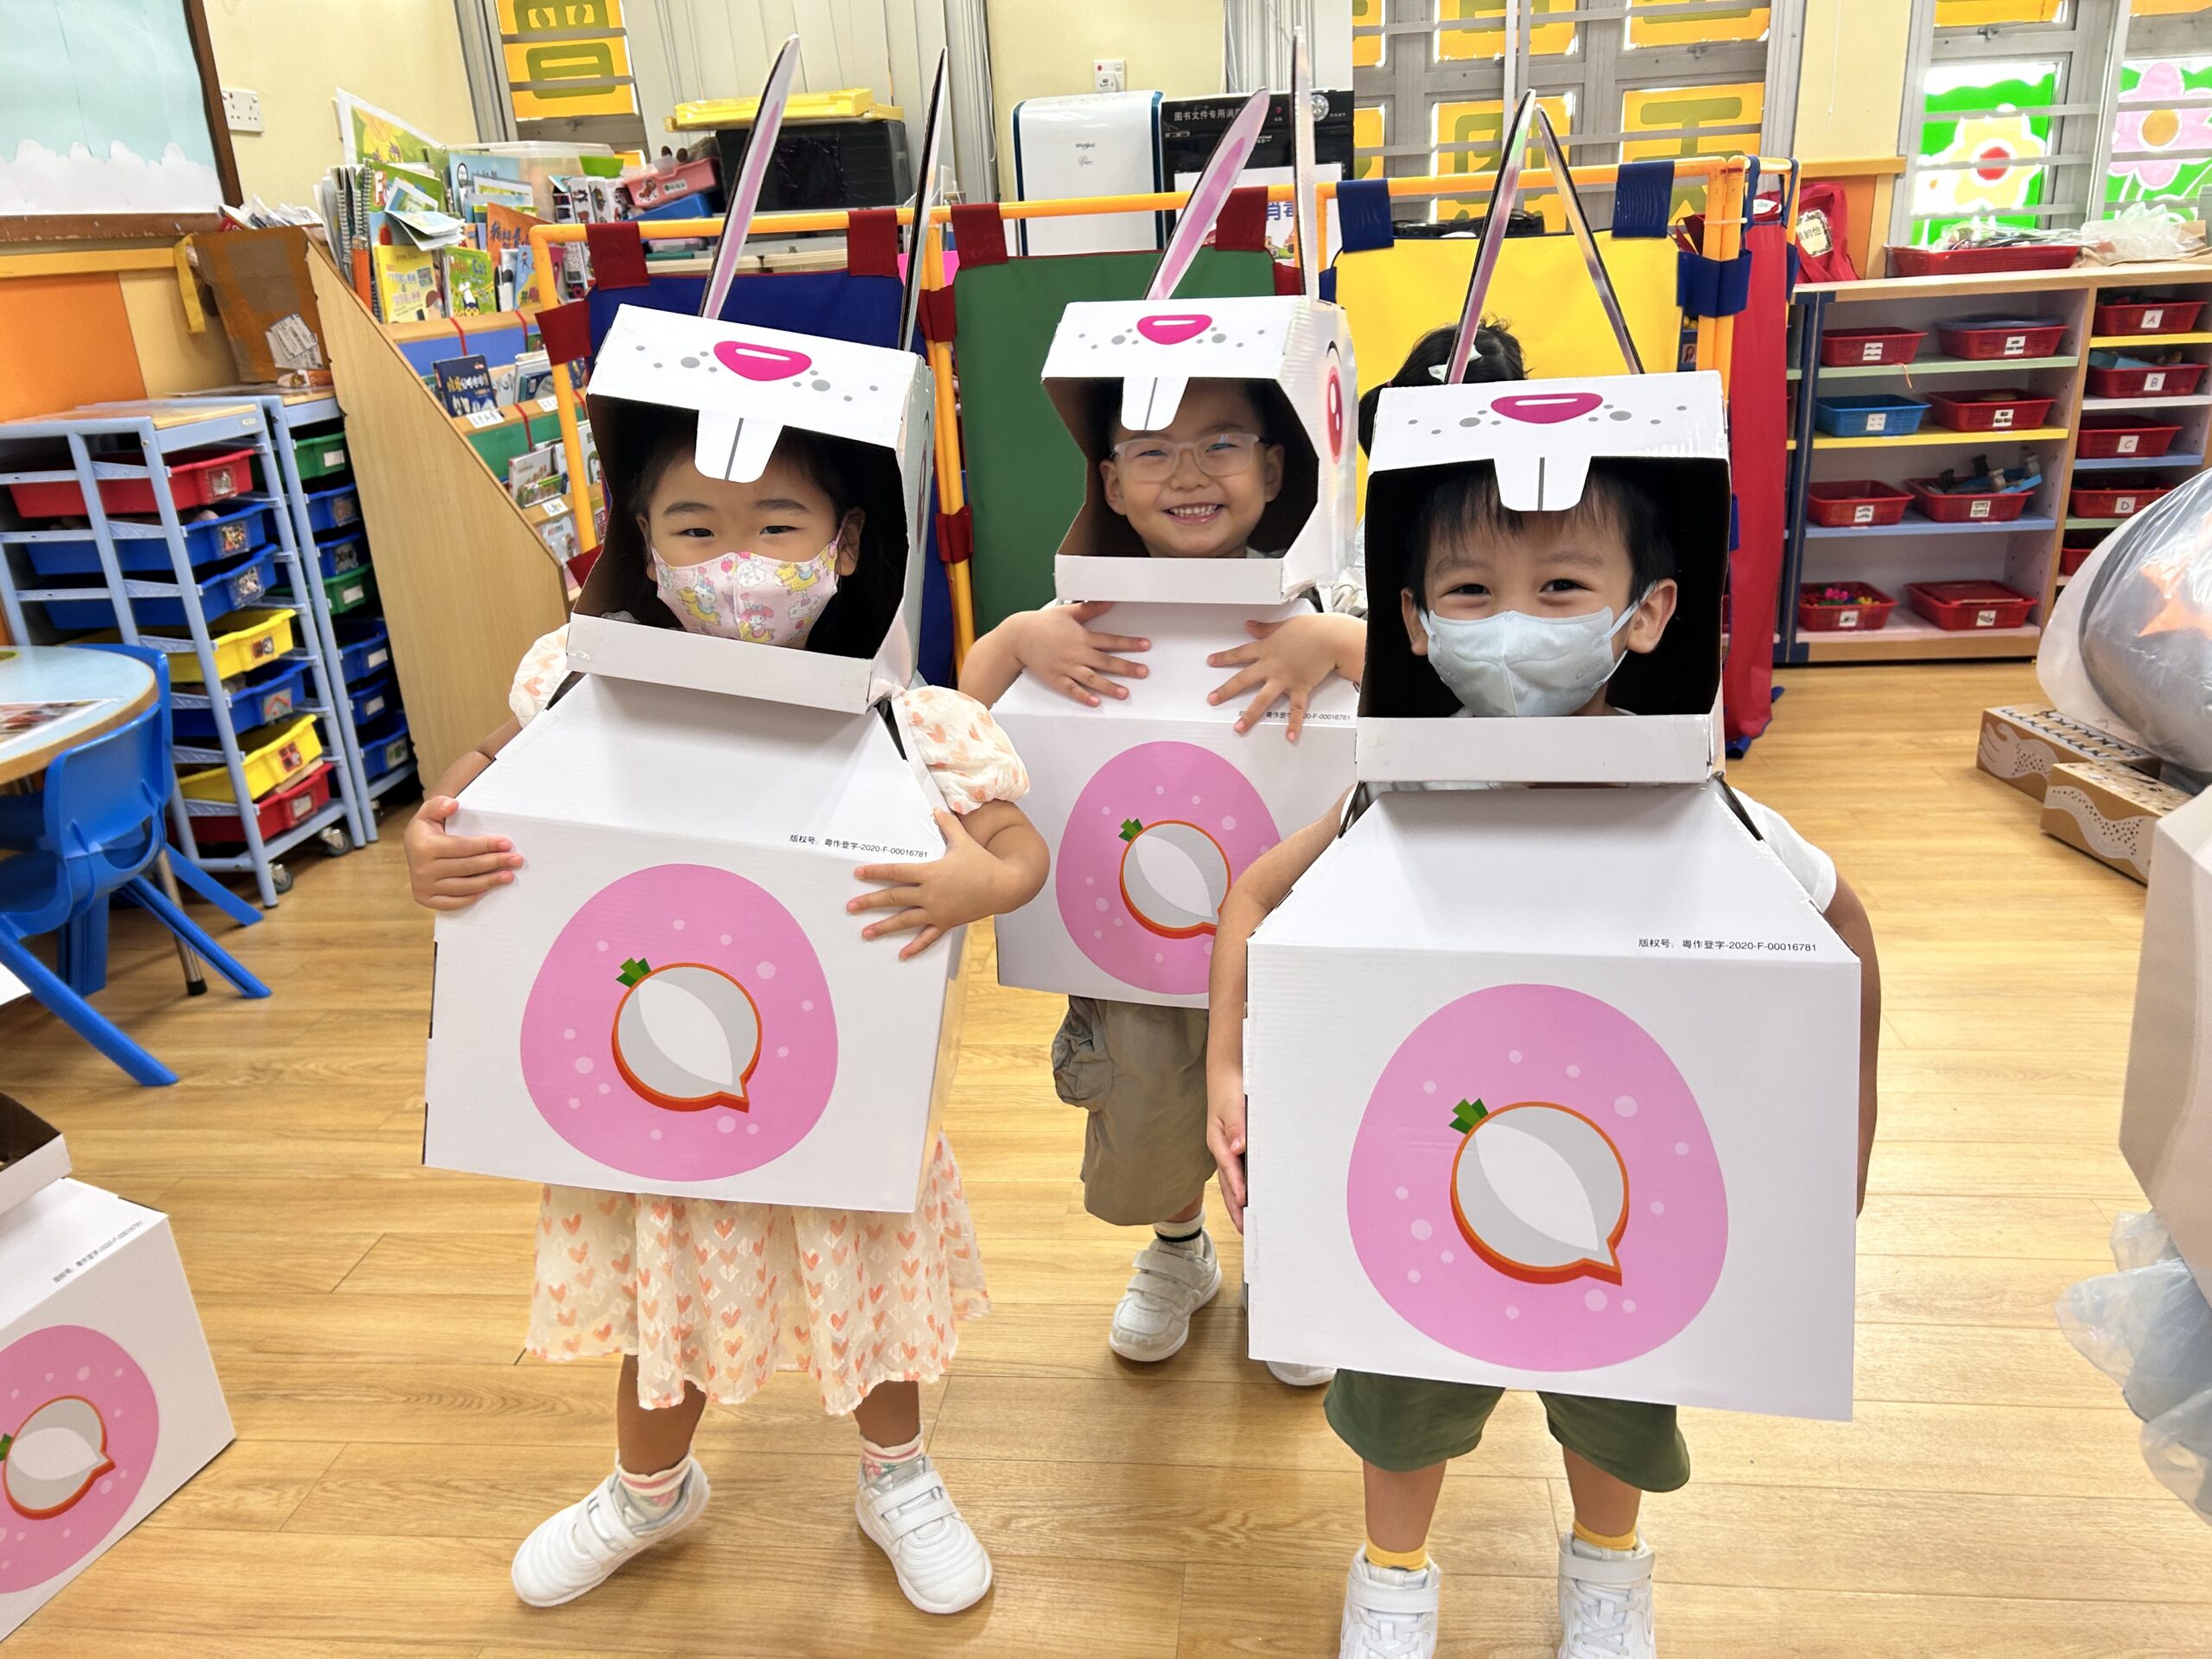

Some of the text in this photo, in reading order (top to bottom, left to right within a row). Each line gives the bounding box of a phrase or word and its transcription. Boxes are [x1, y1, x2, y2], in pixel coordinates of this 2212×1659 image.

[2146, 315, 2157, 325] A
[2150, 377, 2159, 388] B
[2124, 440, 2134, 449] C
[2120, 501, 2130, 511] D
